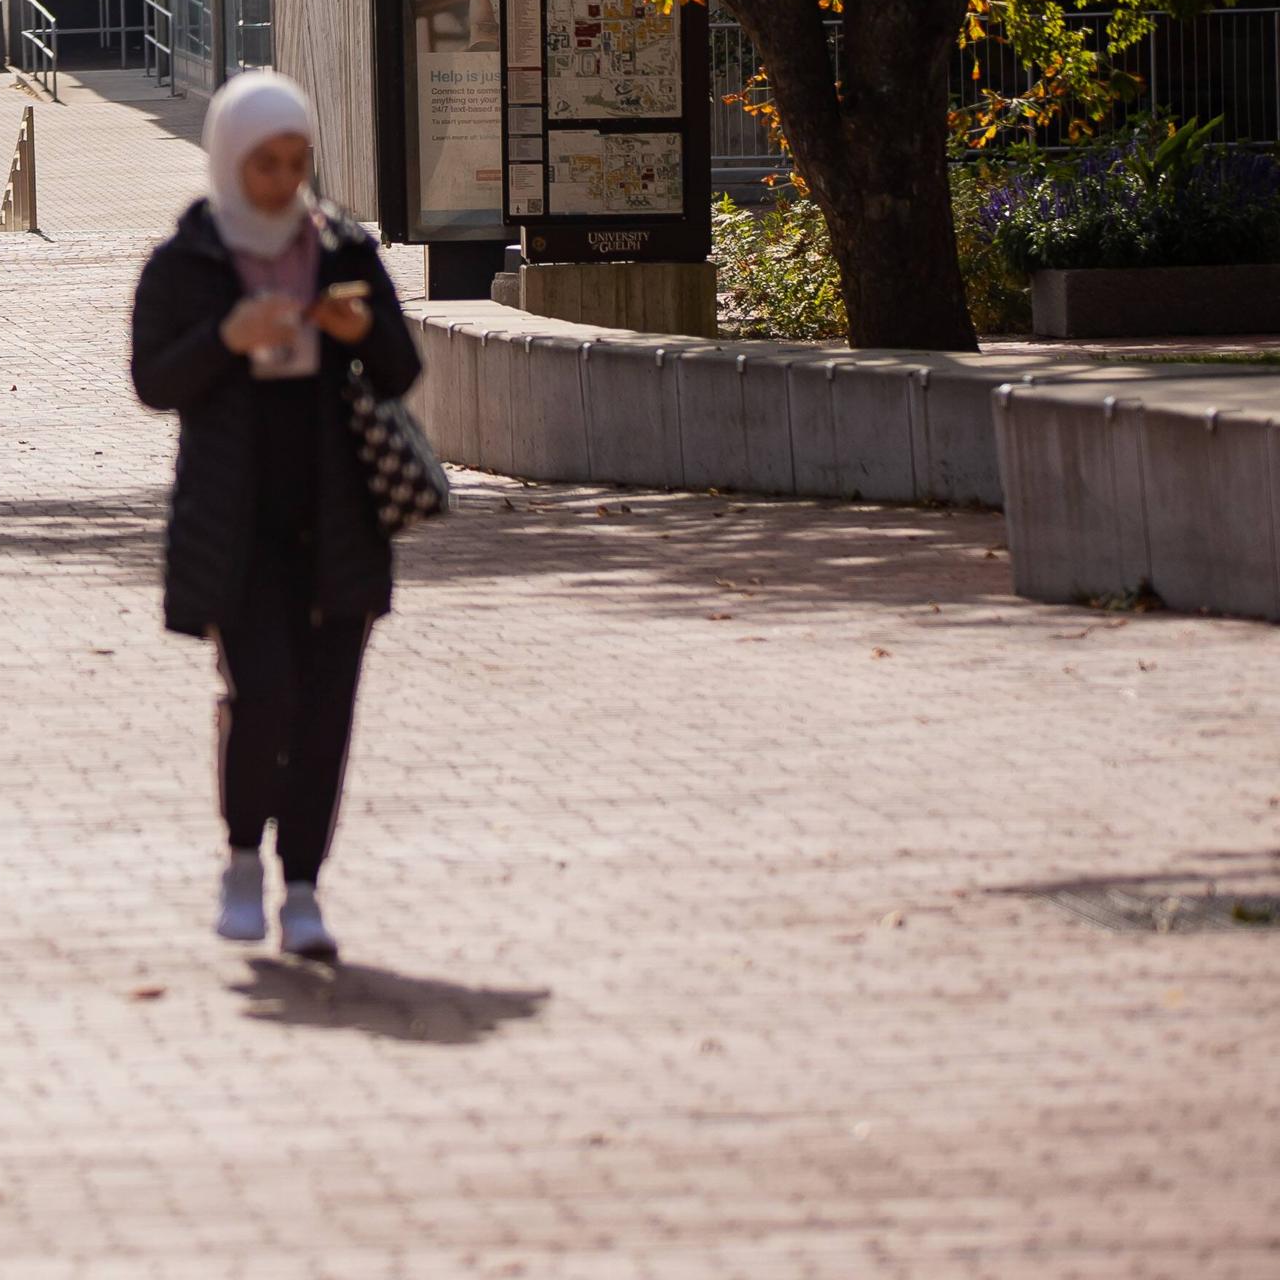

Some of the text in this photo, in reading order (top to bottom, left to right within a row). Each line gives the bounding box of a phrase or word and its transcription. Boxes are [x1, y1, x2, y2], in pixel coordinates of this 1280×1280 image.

[430, 70, 463, 84] Help
[466, 70, 479, 82] is
[431, 97, 466, 106] anything
[480, 97, 497, 105] your
[588, 231, 650, 245] UNIVERSITY
[600, 241, 640, 253] GUELPH
